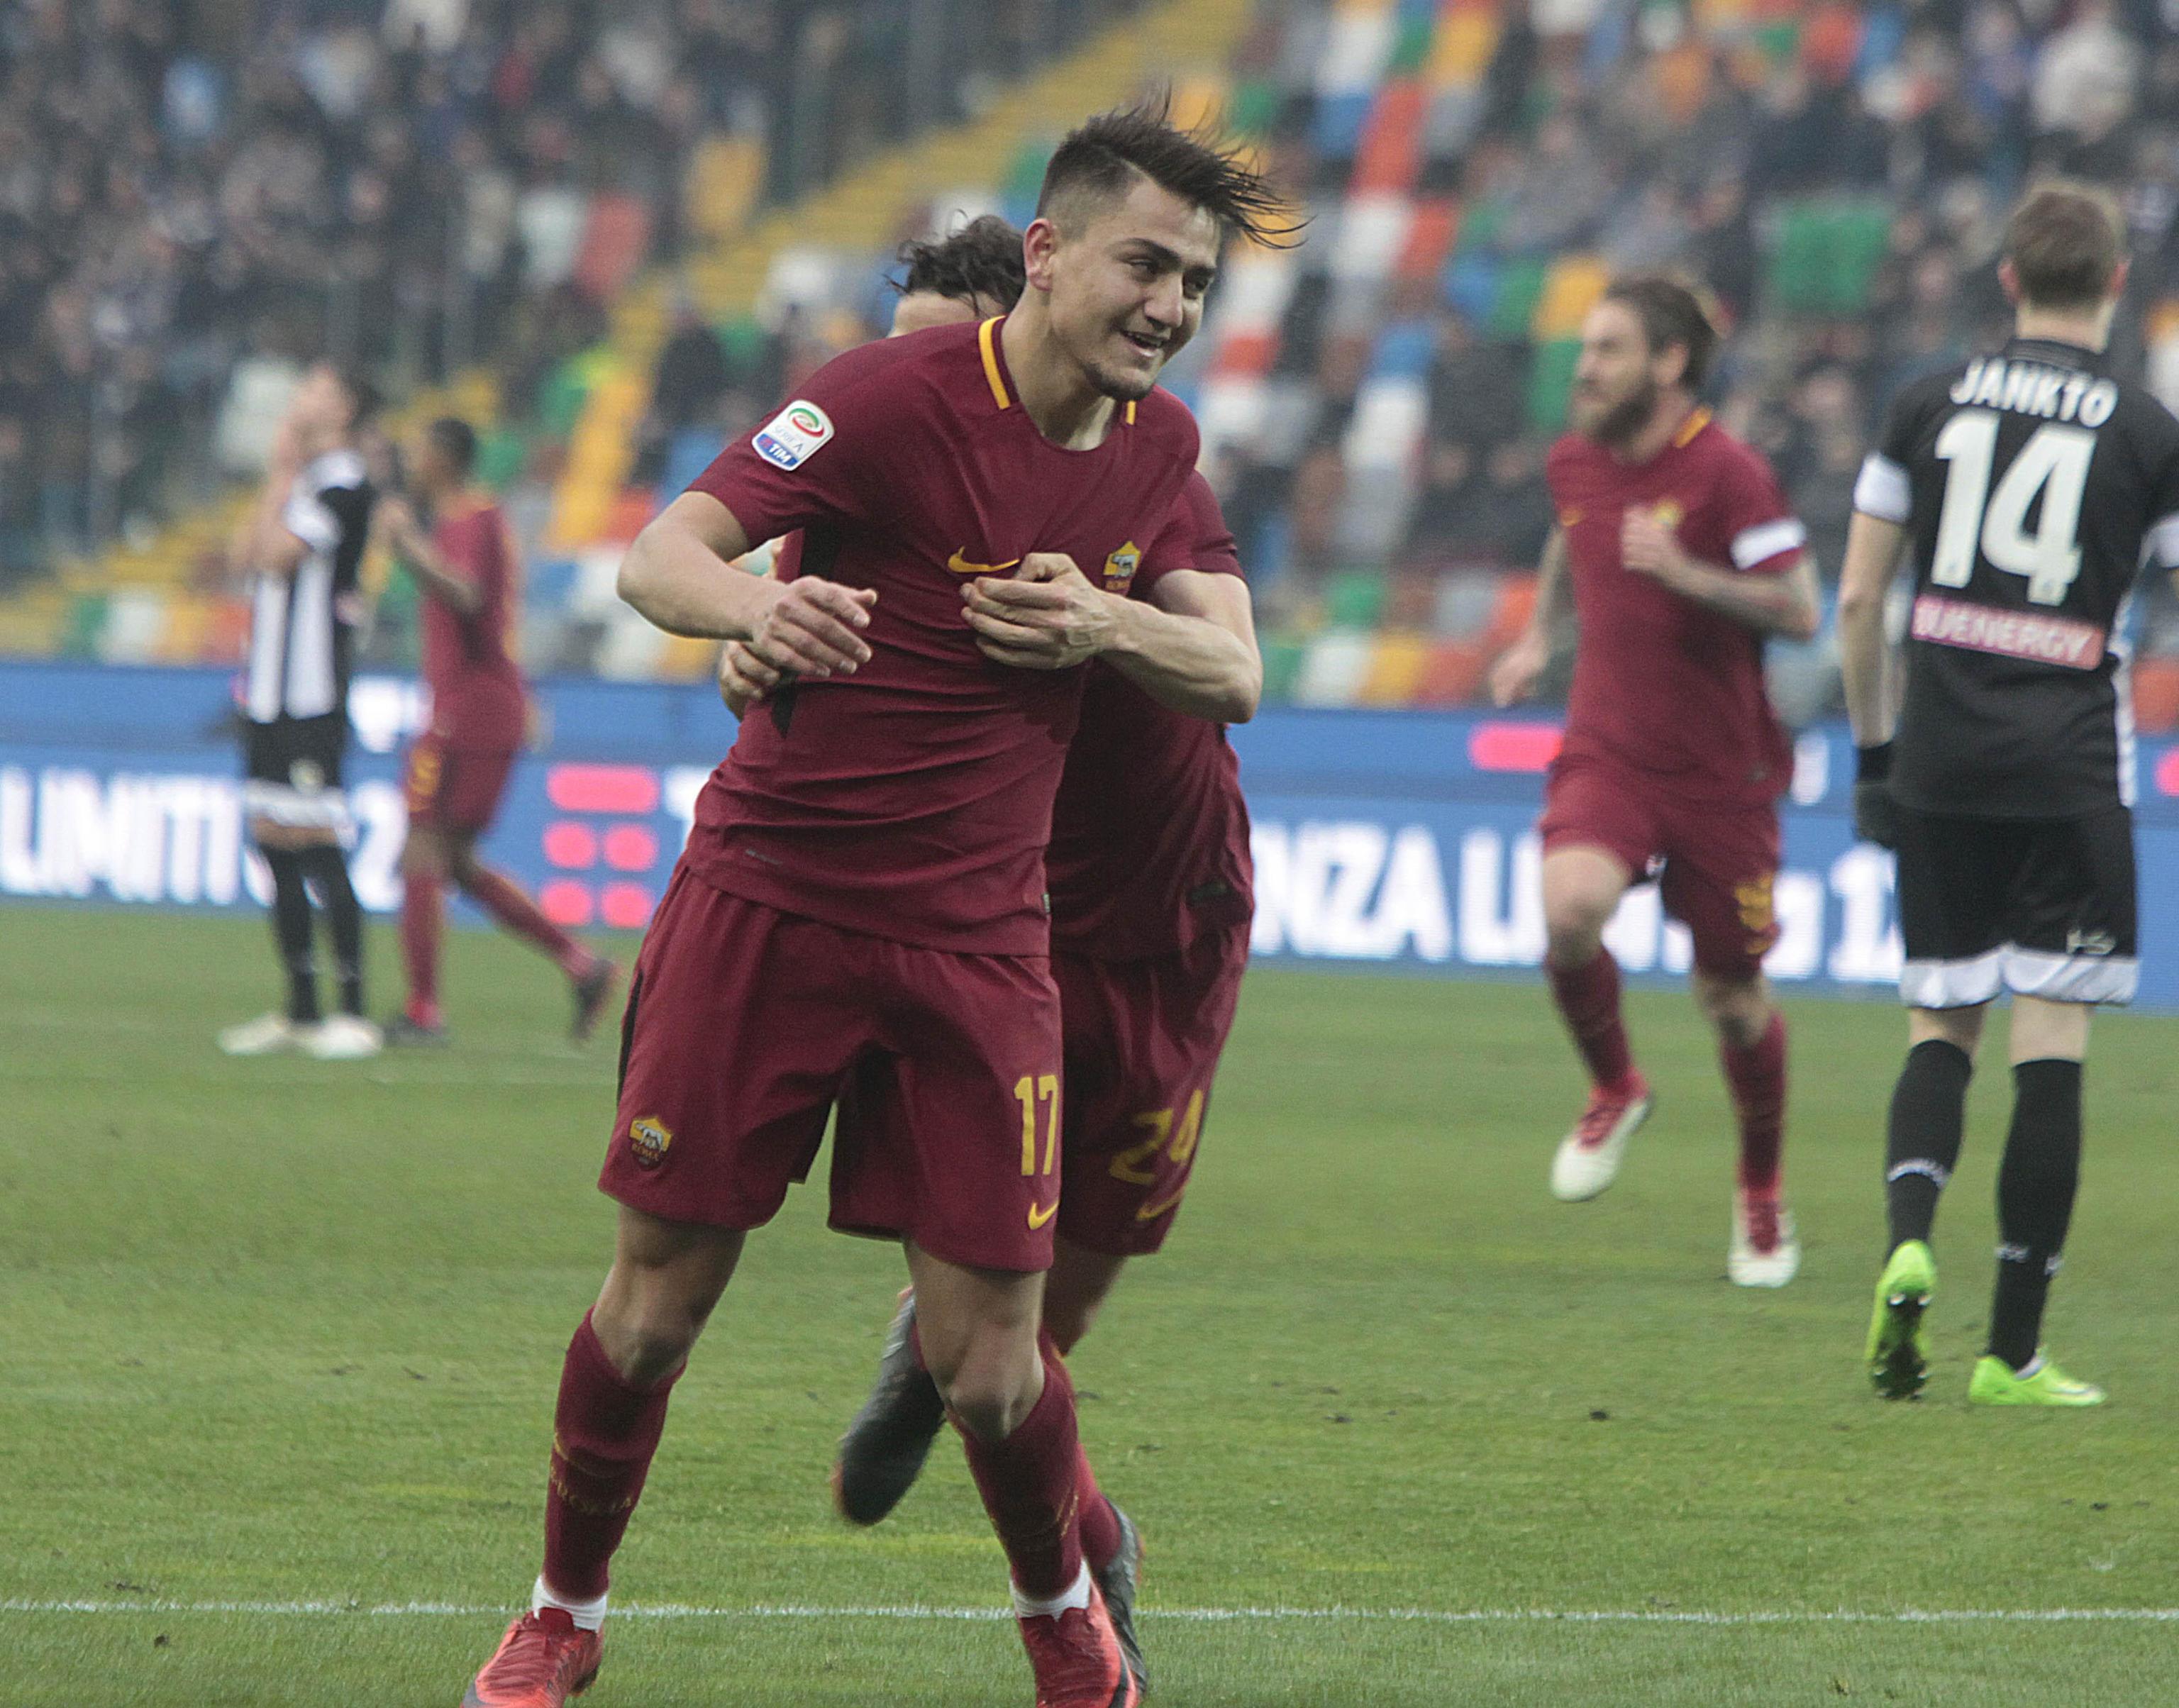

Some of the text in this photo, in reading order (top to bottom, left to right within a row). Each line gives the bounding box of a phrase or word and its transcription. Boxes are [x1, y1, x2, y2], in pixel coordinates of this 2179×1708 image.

[1950, 358, 2119, 428] JANKTO
[768, 443, 792, 463] TIM
[1931, 406, 2097, 606] 14
[1248, 819, 1454, 962] NZA
[1014, 1075, 1059, 1176] 17
